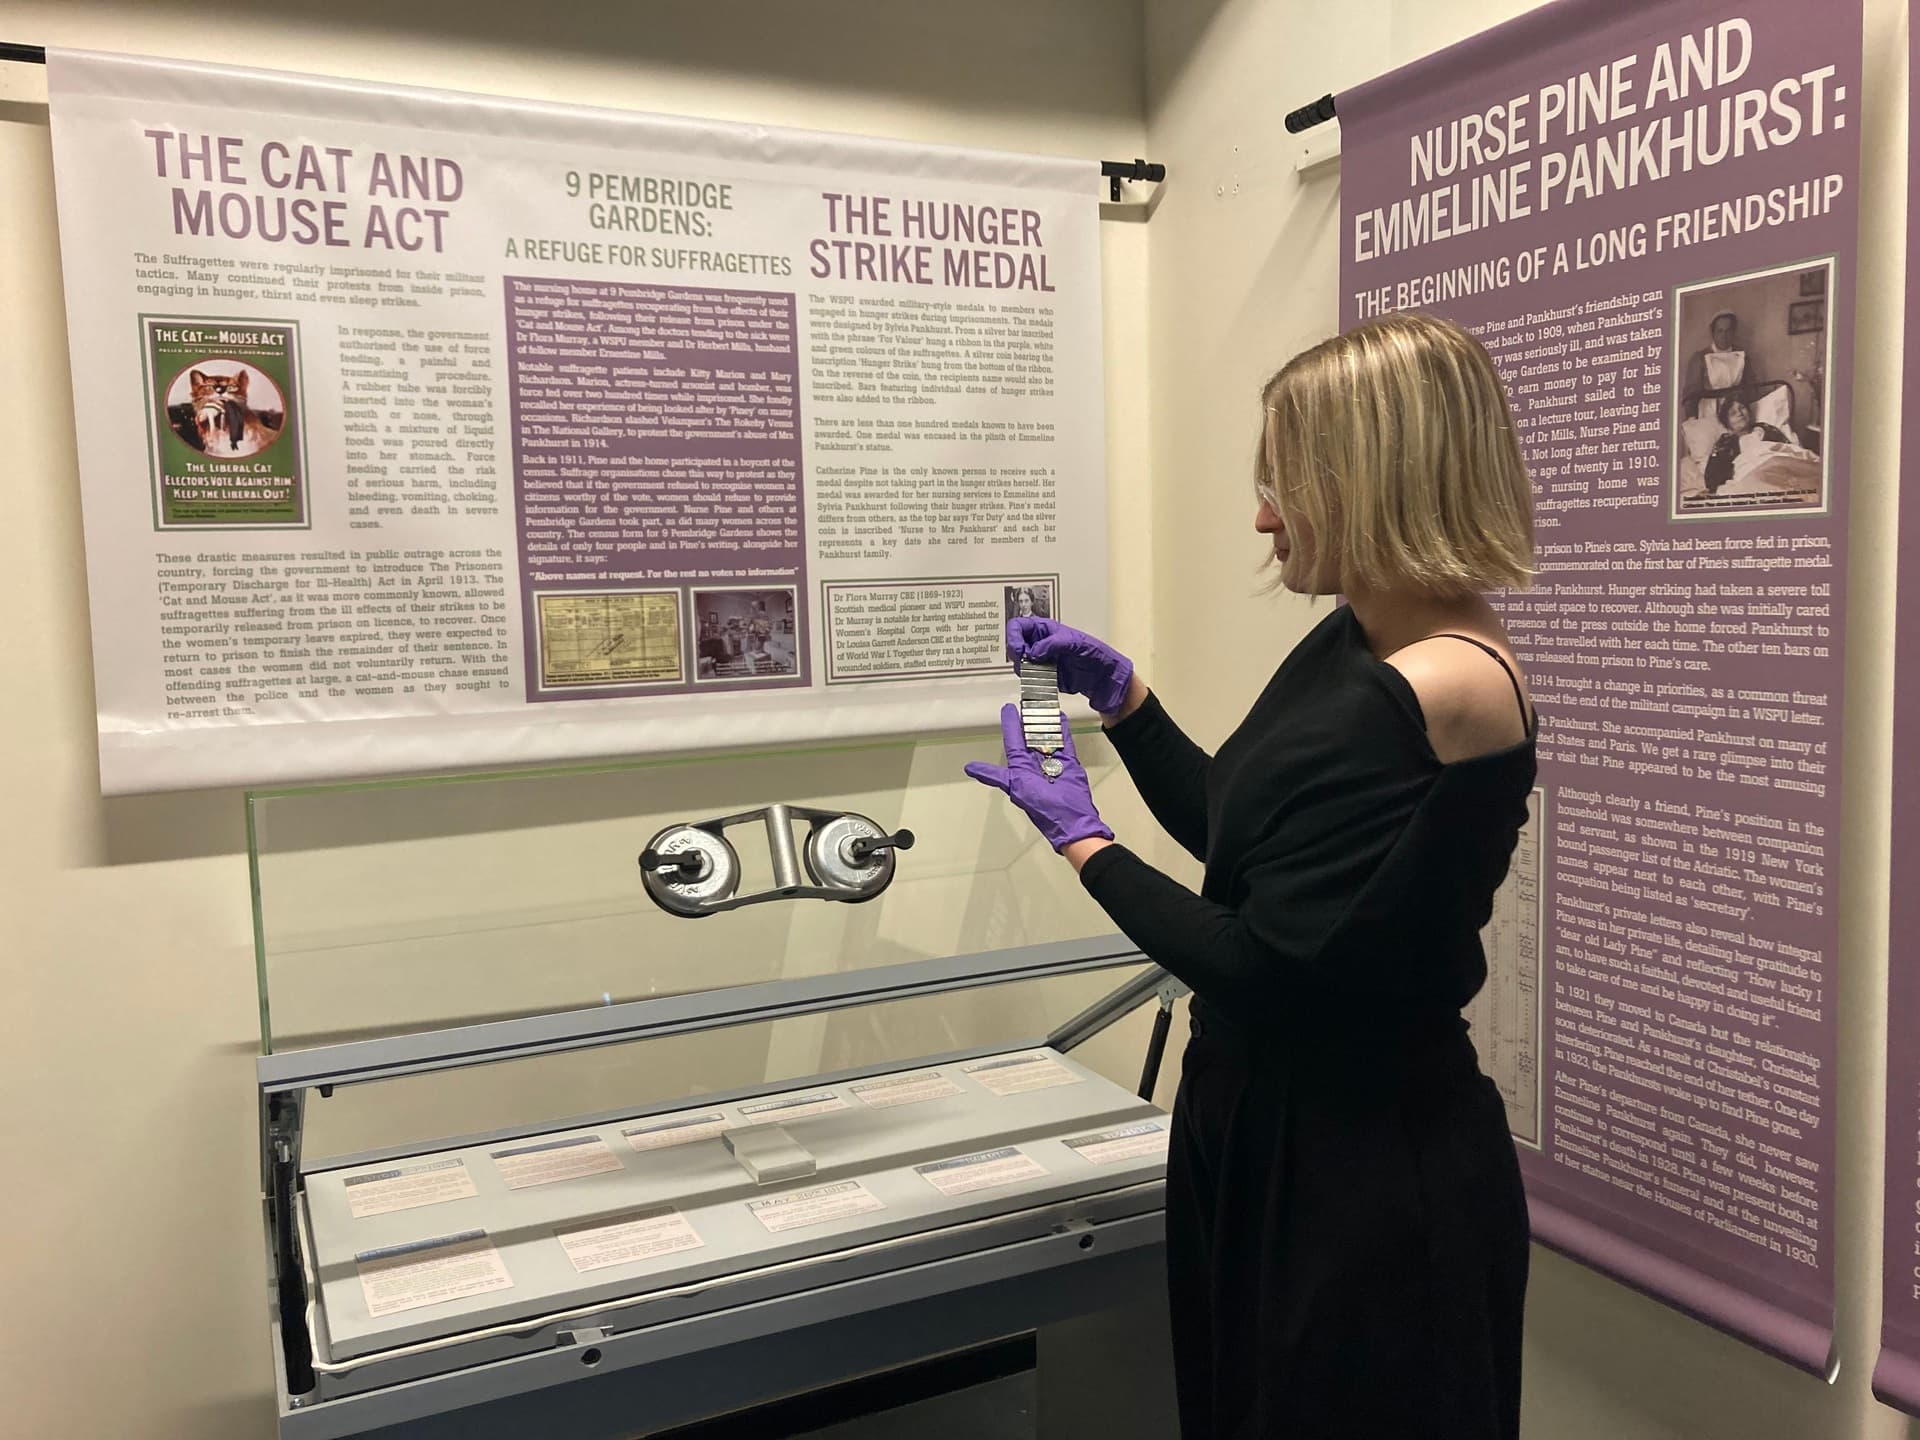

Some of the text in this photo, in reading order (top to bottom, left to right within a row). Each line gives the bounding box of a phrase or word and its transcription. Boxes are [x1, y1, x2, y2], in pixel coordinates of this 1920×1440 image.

[1411, 18, 1752, 186] NURSE PINE AND
[144, 129, 463, 202] THE CAT AND
[1355, 64, 1846, 262] EMMELINE PANKHURST:
[565, 170, 732, 210] 9 PEMBRIDGE
[171, 187, 449, 253] MOUSE ACT
[589, 202, 712, 237] GARDENS:
[821, 192, 1042, 247] THE HUNGER
[505, 237, 791, 276] A REFUGE FOR SUFFRAGETTES
[1355, 175, 1844, 319] THE BEGINNING OF A LONG FRIENDSHIP
[133, 252, 484, 283] The Suffragettes were regularly imprisoned for their militant
[809, 238, 1055, 292] STRIKE MEDAL
[136, 284, 193, 297] engaging
[197, 285, 209, 295] in
[261, 288, 292, 300] thirst
[295, 292, 316, 302] and
[319, 295, 346, 303] even
[349, 295, 378, 307] sleep
[186, 269, 219, 284] Many
[227, 274, 285, 285] continued
[292, 276, 319, 288] their
[326, 280, 371, 291] protests
[378, 281, 403, 292] from
[410, 284, 442, 294] inside
[1486, 320, 1505, 333] Pine
[1507, 314, 1524, 328] and
[1585, 292, 1639, 313] friendship
[1642, 290, 1662, 302] can
[155, 328, 178, 342] THE
[181, 329, 202, 342] CAT
[219, 330, 258, 344] MOUSE
[261, 332, 284, 345] ACT
[1501, 332, 1523, 346] back
[1525, 332, 1534, 342] to
[1567, 321, 1595, 334] when
[341, 380, 492, 397] A rubber tube was forcibly
[165, 474, 209, 486] ELECTORS
[210, 476, 232, 486] VOTE
[235, 476, 271, 486] AGAINST
[185, 462, 271, 472] THE LIBERAL CAT
[815, 465, 855, 474] Catherine
[859, 466, 877, 475] Pine
[881, 466, 889, 475] is
[892, 466, 906, 475] the
[909, 466, 928, 477] only
[931, 466, 958, 475] known
[961, 468, 986, 477] person
[989, 467, 997, 475] to
[1000, 468, 1026, 476] receive
[1029, 467, 1047, 475] such
[173, 487, 289, 498] KEEP THE LIBERAL OUT!
[232, 579, 288, 591] Discharge
[294, 578, 310, 588] for
[377, 576, 395, 586] Act
[400, 576, 411, 585] in
[416, 575, 443, 587] April
[483, 574, 503, 583] The
[833, 593, 843, 602] Dr
[845, 592, 867, 601] Flora
[869, 592, 898, 602] Murray
[899, 590, 915, 600] CBE
[833, 604, 864, 613] Scottish
[867, 603, 896, 612] medical
[899, 602, 926, 613] pioneer
[928, 601, 942, 609] and
[944, 600, 965, 609] WSPU
[1506, 617, 1829, 636] presence of the press outside the home forced Pankhurst to
[1557, 821, 1575, 832] and
[1624, 832, 1636, 843] as
[1641, 833, 1677, 850] shown
[1682, 839, 1694, 853] in
[1699, 843, 1718, 856] the
[1725, 846, 1755, 863] 1919
[1761, 852, 1789, 869] New
[1794, 858, 1824, 876] York
[1553, 1152, 1563, 1163] of
[1564, 1154, 1580, 1169] her
[1581, 1163, 1610, 1182] statue
[1611, 1175, 1634, 1192] near
[1635, 1184, 1652, 1199] the
[1654, 1197, 1691, 1215] Houses
[1693, 1209, 1705, 1221] of
[1706, 1213, 1767, 1246] Parliament
[1769, 1236, 1781, 1253] in
